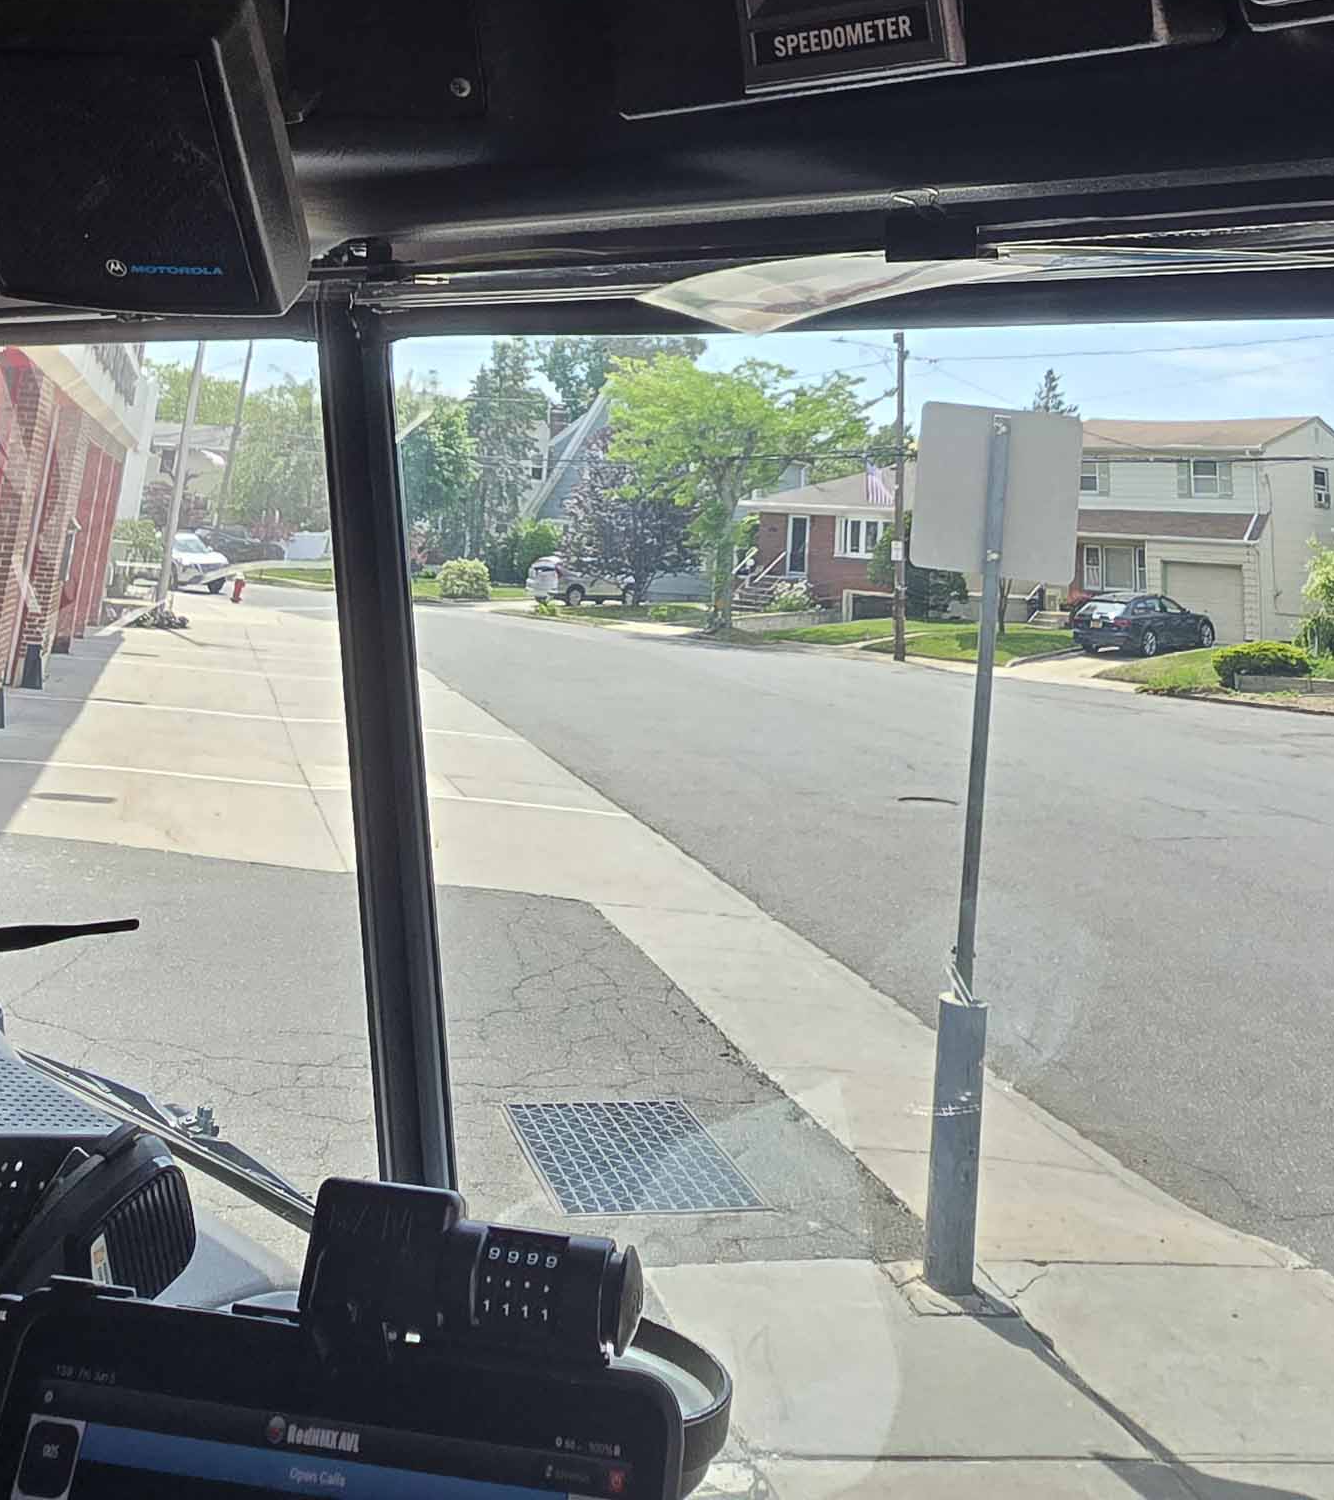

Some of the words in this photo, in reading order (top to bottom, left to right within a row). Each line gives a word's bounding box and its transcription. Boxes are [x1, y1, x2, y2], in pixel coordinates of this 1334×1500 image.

[773, 15, 912, 57] SPEEDOMETER
[130, 264, 224, 276] MOTOROLA
[289, 1467, 317, 1485] Open
[318, 1470, 347, 1488] Calls
